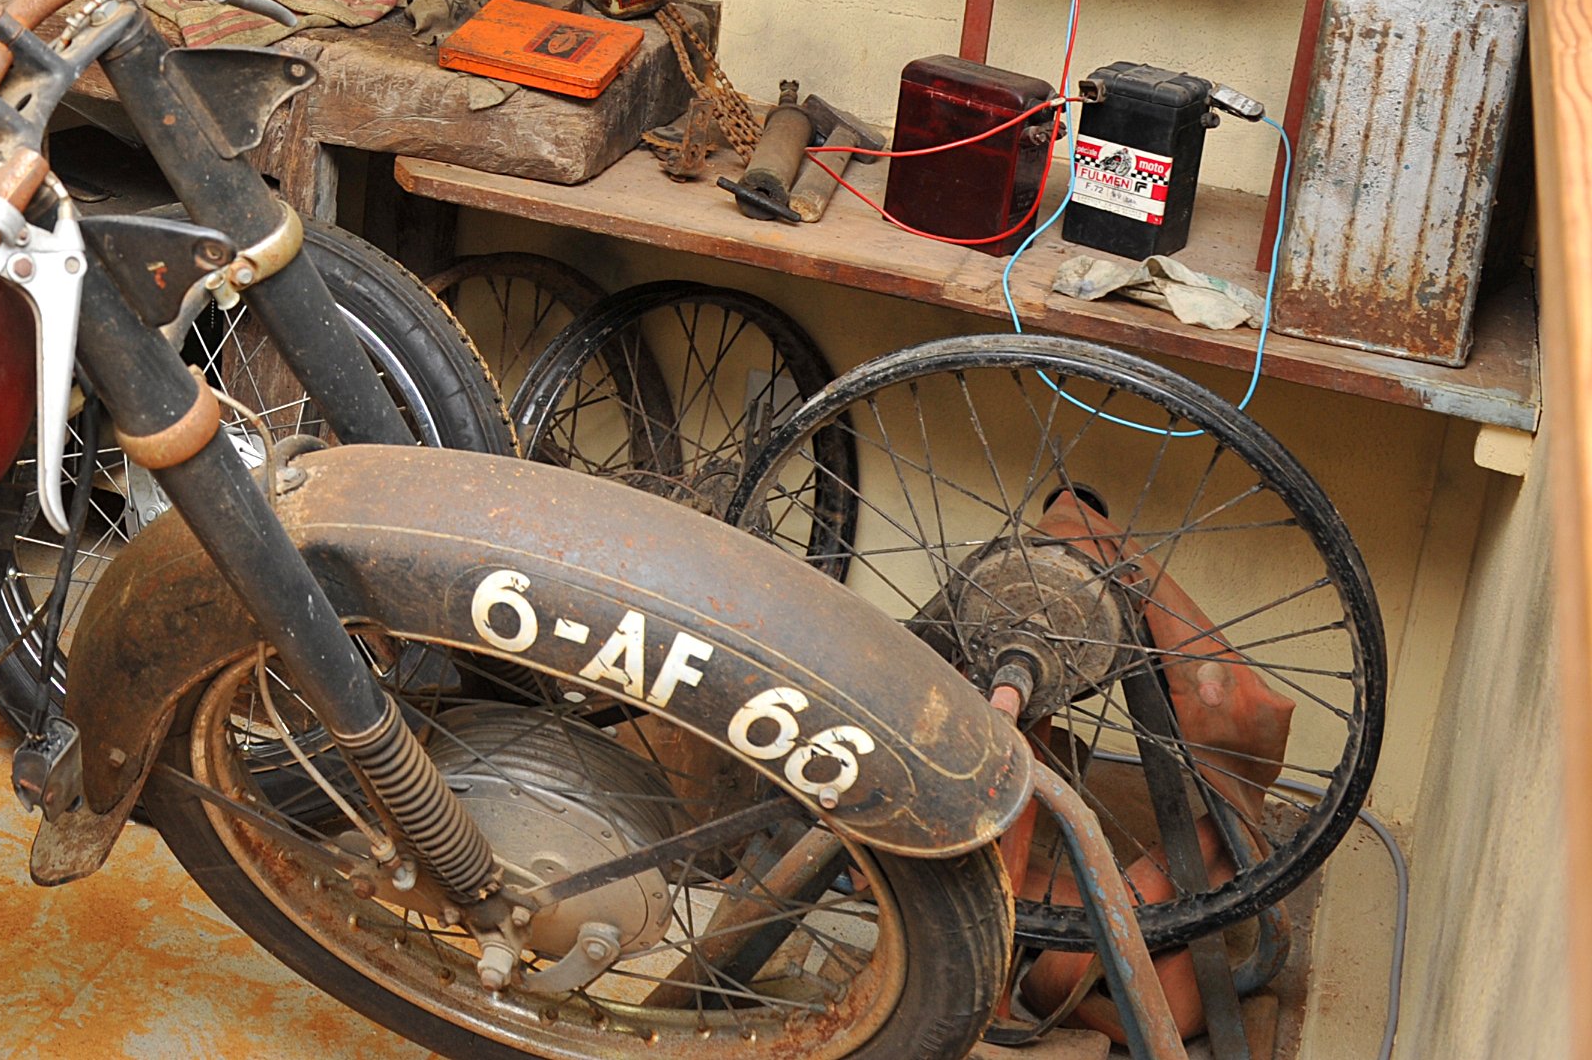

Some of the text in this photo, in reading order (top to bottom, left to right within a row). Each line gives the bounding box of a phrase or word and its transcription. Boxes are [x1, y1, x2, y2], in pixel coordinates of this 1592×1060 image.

[1138, 160, 1164, 174] moto
[1080, 168, 1130, 189] FULMEN
[1085, 182, 1104, 193] F.72
[727, 686, 876, 797] 66
